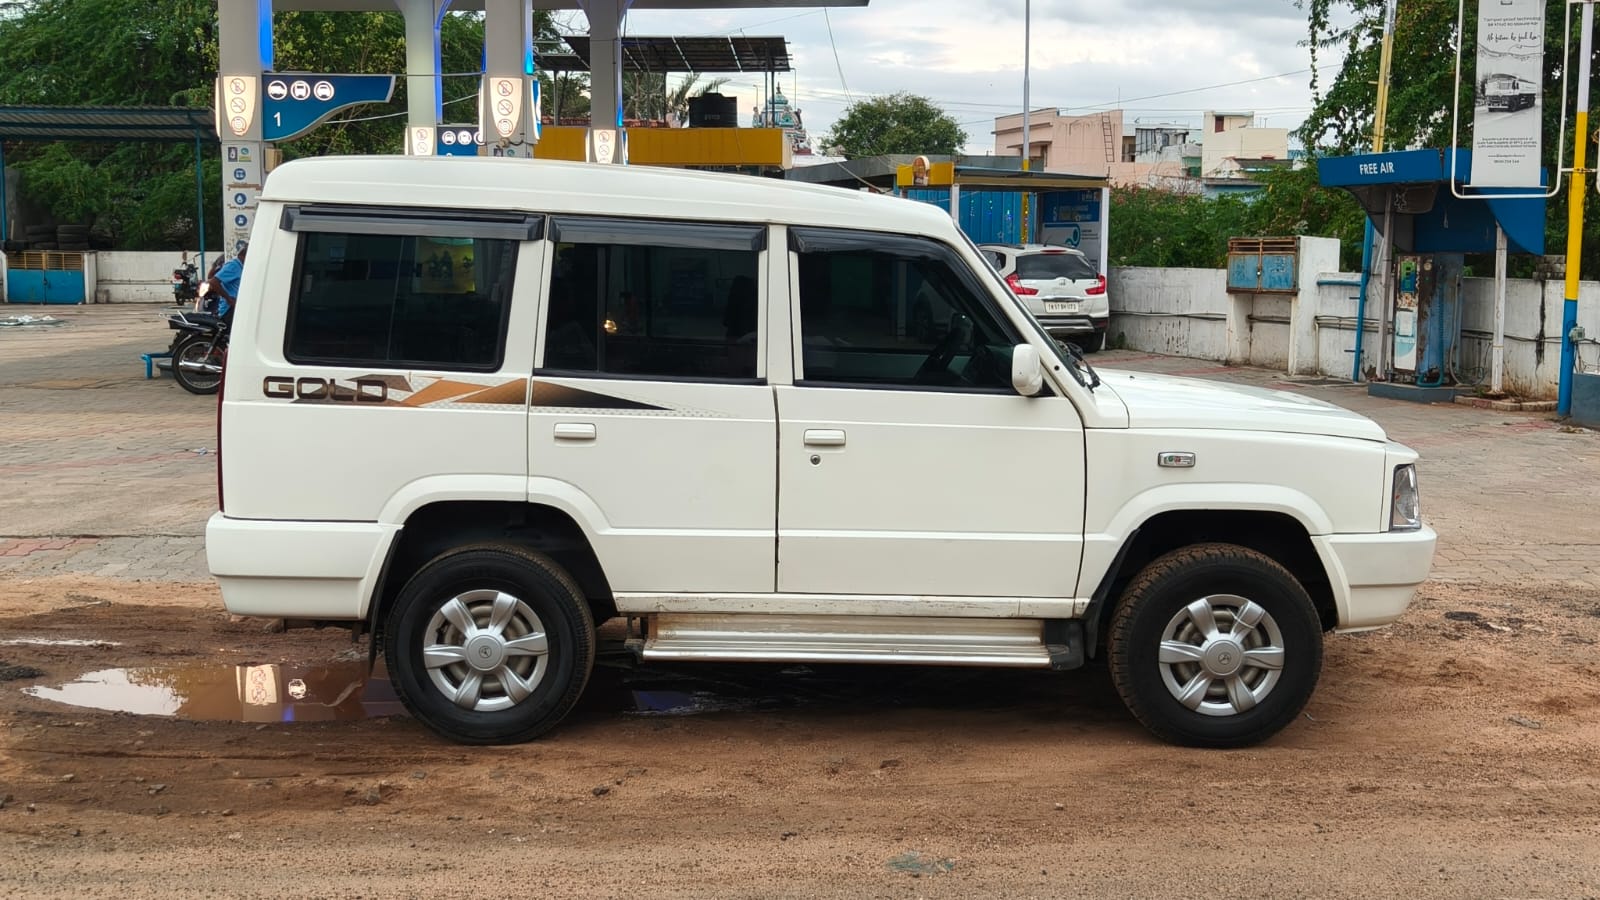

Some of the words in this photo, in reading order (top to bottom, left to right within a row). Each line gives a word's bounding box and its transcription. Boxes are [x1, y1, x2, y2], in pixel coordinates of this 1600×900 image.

[273, 112, 281, 127] 1
[1359, 163, 1379, 176] FREE
[1379, 162, 1394, 175] AIR
[262, 375, 389, 403] GOLD
